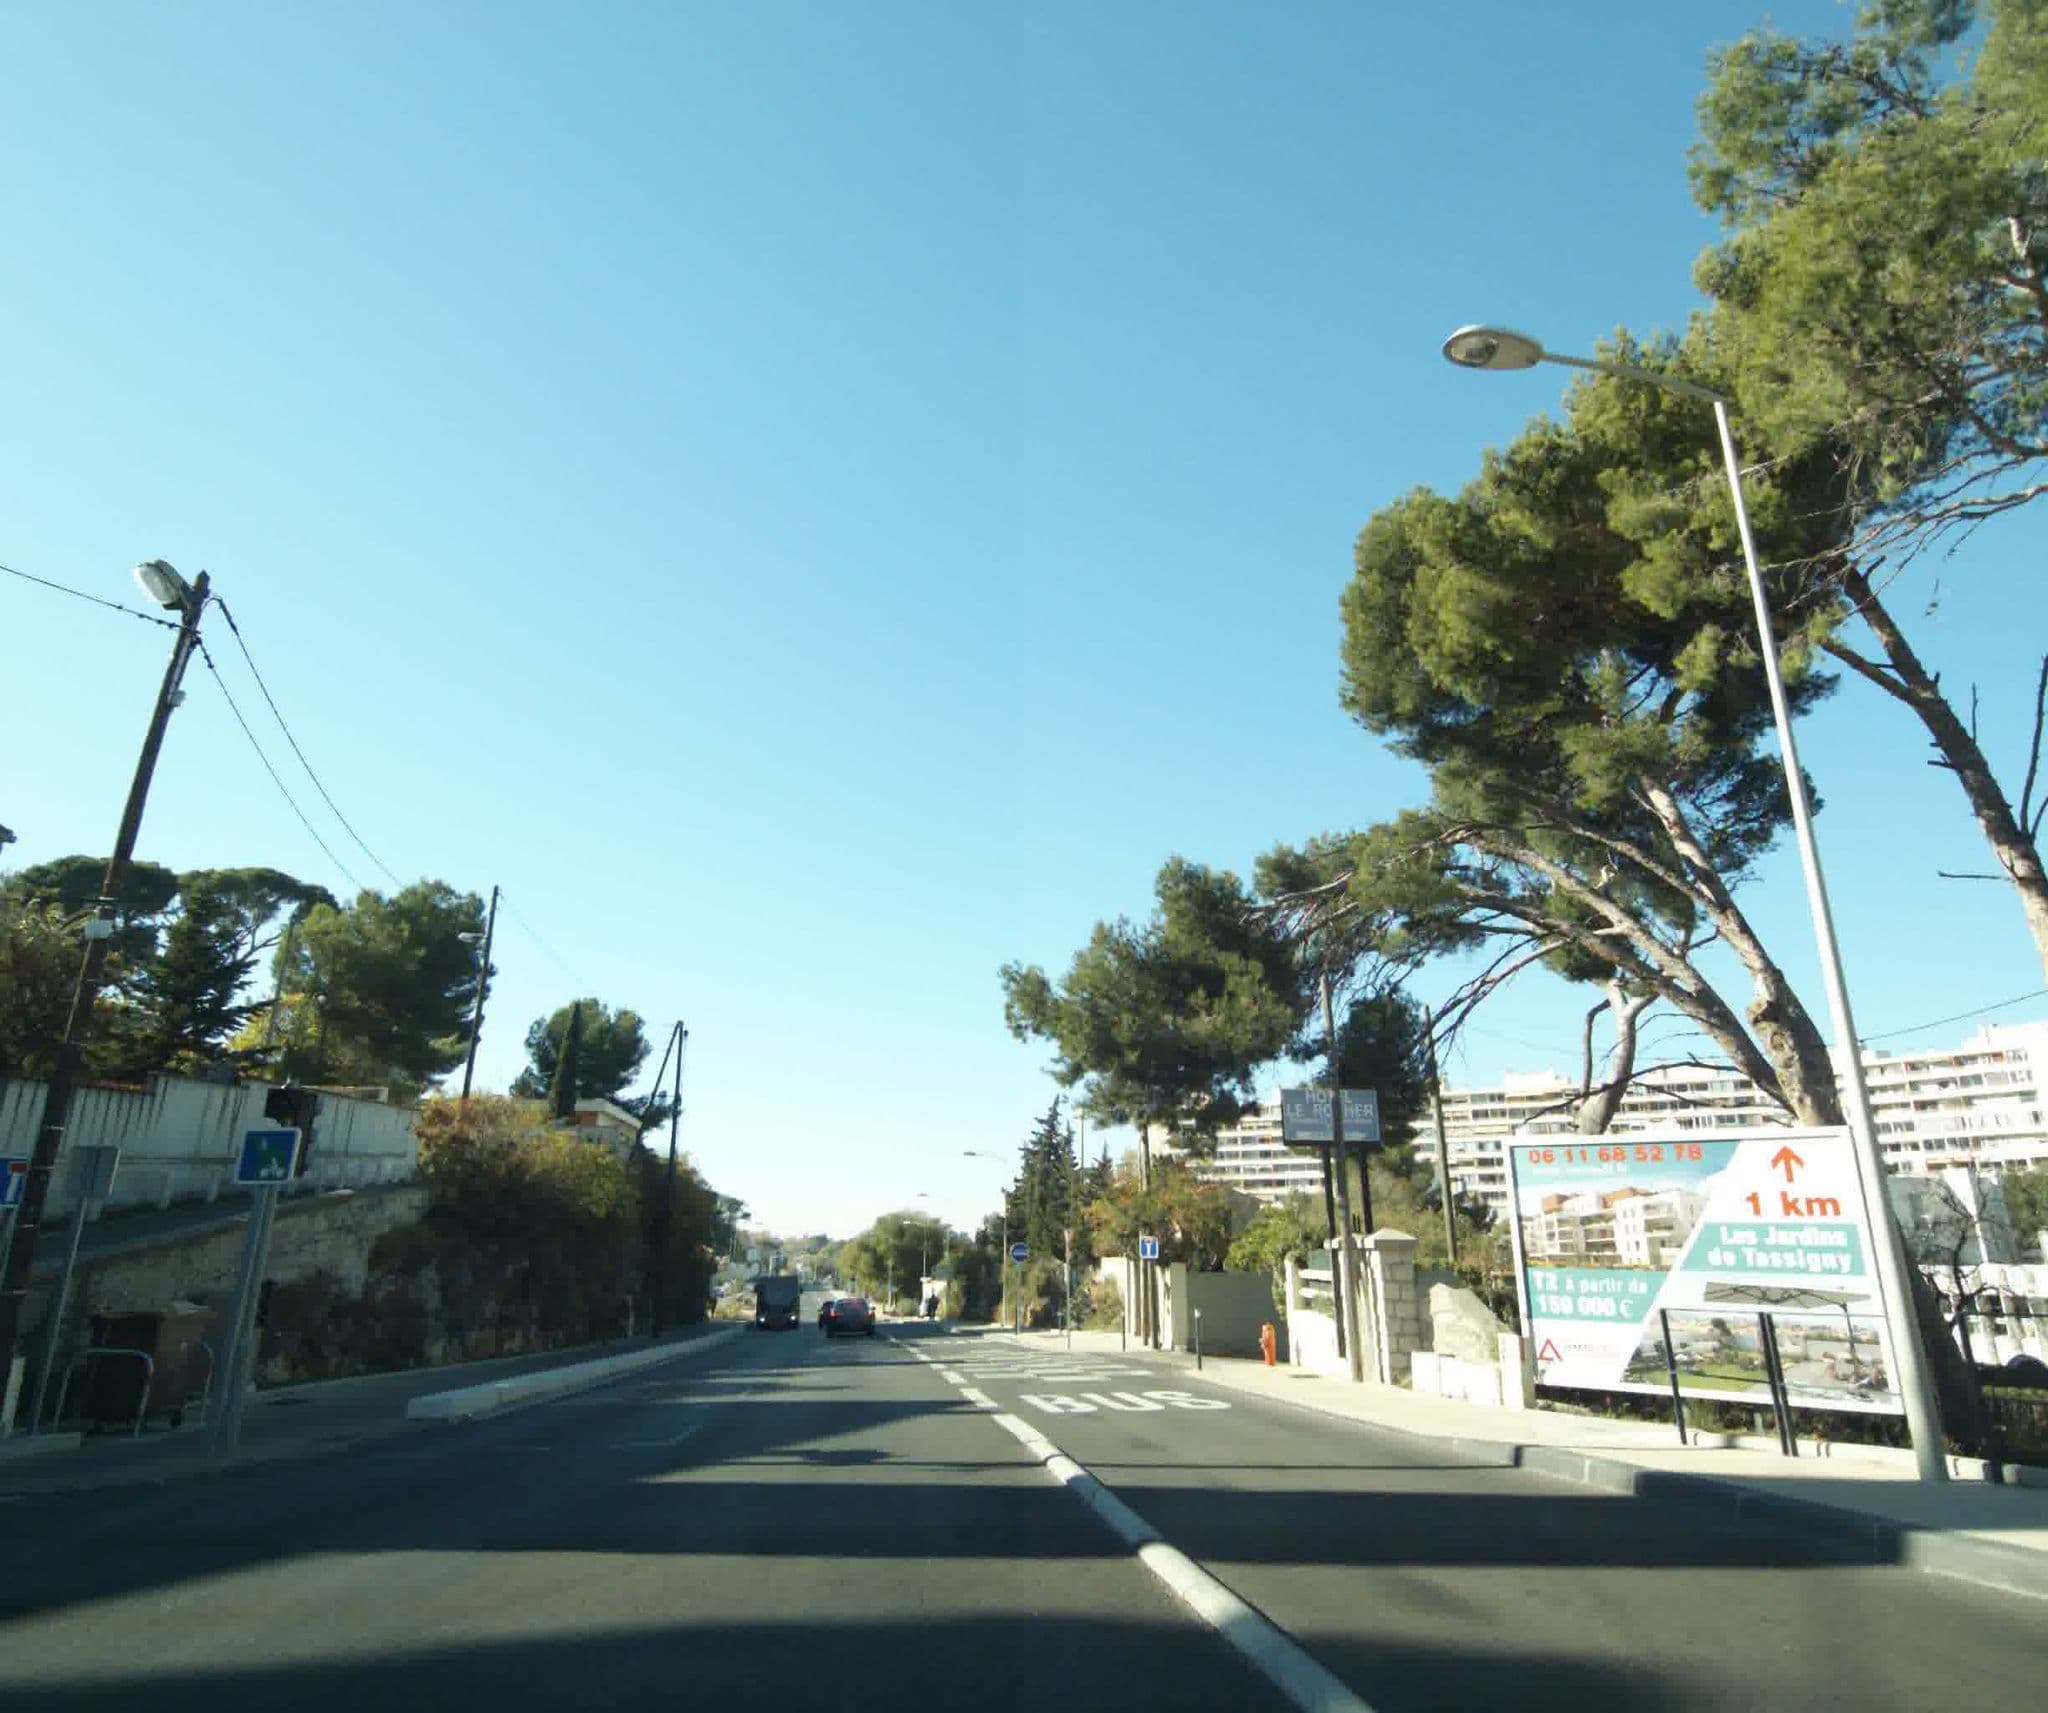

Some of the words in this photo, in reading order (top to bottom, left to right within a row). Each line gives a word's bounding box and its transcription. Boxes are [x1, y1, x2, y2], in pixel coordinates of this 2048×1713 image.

[1286, 1104, 1304, 1118] LE
[1313, 1104, 1374, 1118] ROHER
[1529, 1148, 1554, 1164] 06
[1564, 1146, 1589, 1163] 11
[1634, 1144, 1663, 1162] 52
[1746, 1192, 1761, 1216] 1
[1780, 1191, 1841, 1216] km
[1720, 1225, 1757, 1245] Les
[1763, 1225, 1848, 1247] Jardins
[1708, 1247, 1736, 1266] de
[1533, 1271, 1557, 1290] T2
[1580, 1277, 1623, 1293] partir
[1629, 1278, 1648, 1293] de
[1620, 1299, 1634, 1318] €
[1019, 1391, 1233, 1413] BUS
